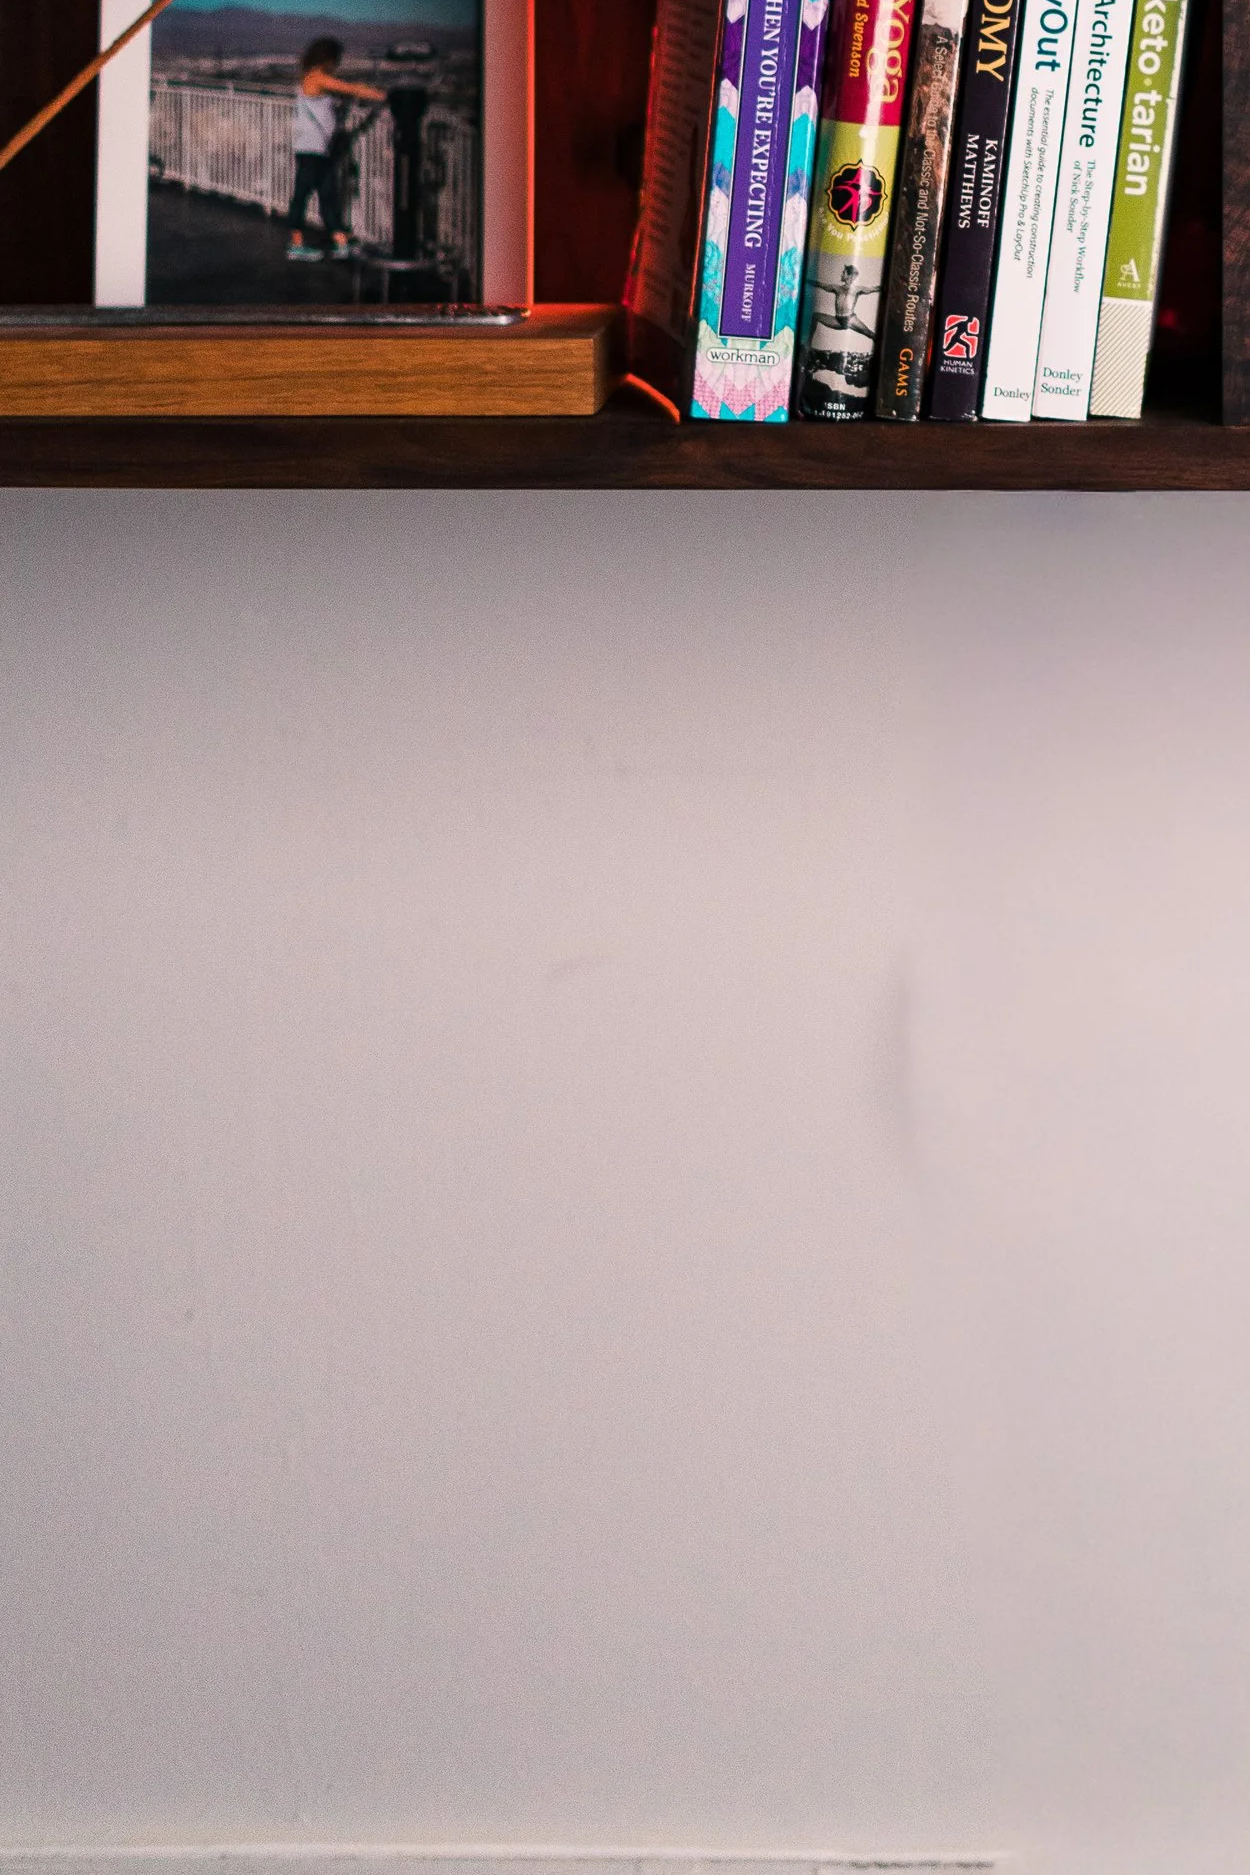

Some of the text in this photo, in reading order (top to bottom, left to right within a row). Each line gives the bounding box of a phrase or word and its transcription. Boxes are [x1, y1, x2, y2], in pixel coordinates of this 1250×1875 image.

[849, 13, 869, 78] Swenson
[1027, 87, 1040, 137] documents
[1024, 139, 1034, 159] with
[744, 129, 772, 249] EXPECTING
[903, 35, 948, 332] A Select Guide to the Classic and Not-So-Classic Routes
[958, 133, 979, 229] MATTHEWS
[977, 139, 998, 228] KAMINOFF
[1019, 161, 1032, 201] SketchUp
[1026, 89, 1054, 278] The essential guide to creating construction
[1067, 160, 1081, 233] of Nick Sonder
[827, 223, 843, 239] You
[1018, 204, 1026, 218] Pro
[1073, 160, 1096, 293] The Step-by-Step Workflow
[1013, 229, 1024, 261] LayOut
[741, 263, 756, 322] MURKOFF
[710, 349, 776, 364] workman
[895, 348, 914, 396] GAMS
[940, 366, 975, 375] KINETICS
[943, 359, 973, 368] HUMAN
[1043, 367, 1083, 382] Donley
[993, 387, 1031, 401] Donley
[1040, 382, 1082, 397] Sonder
